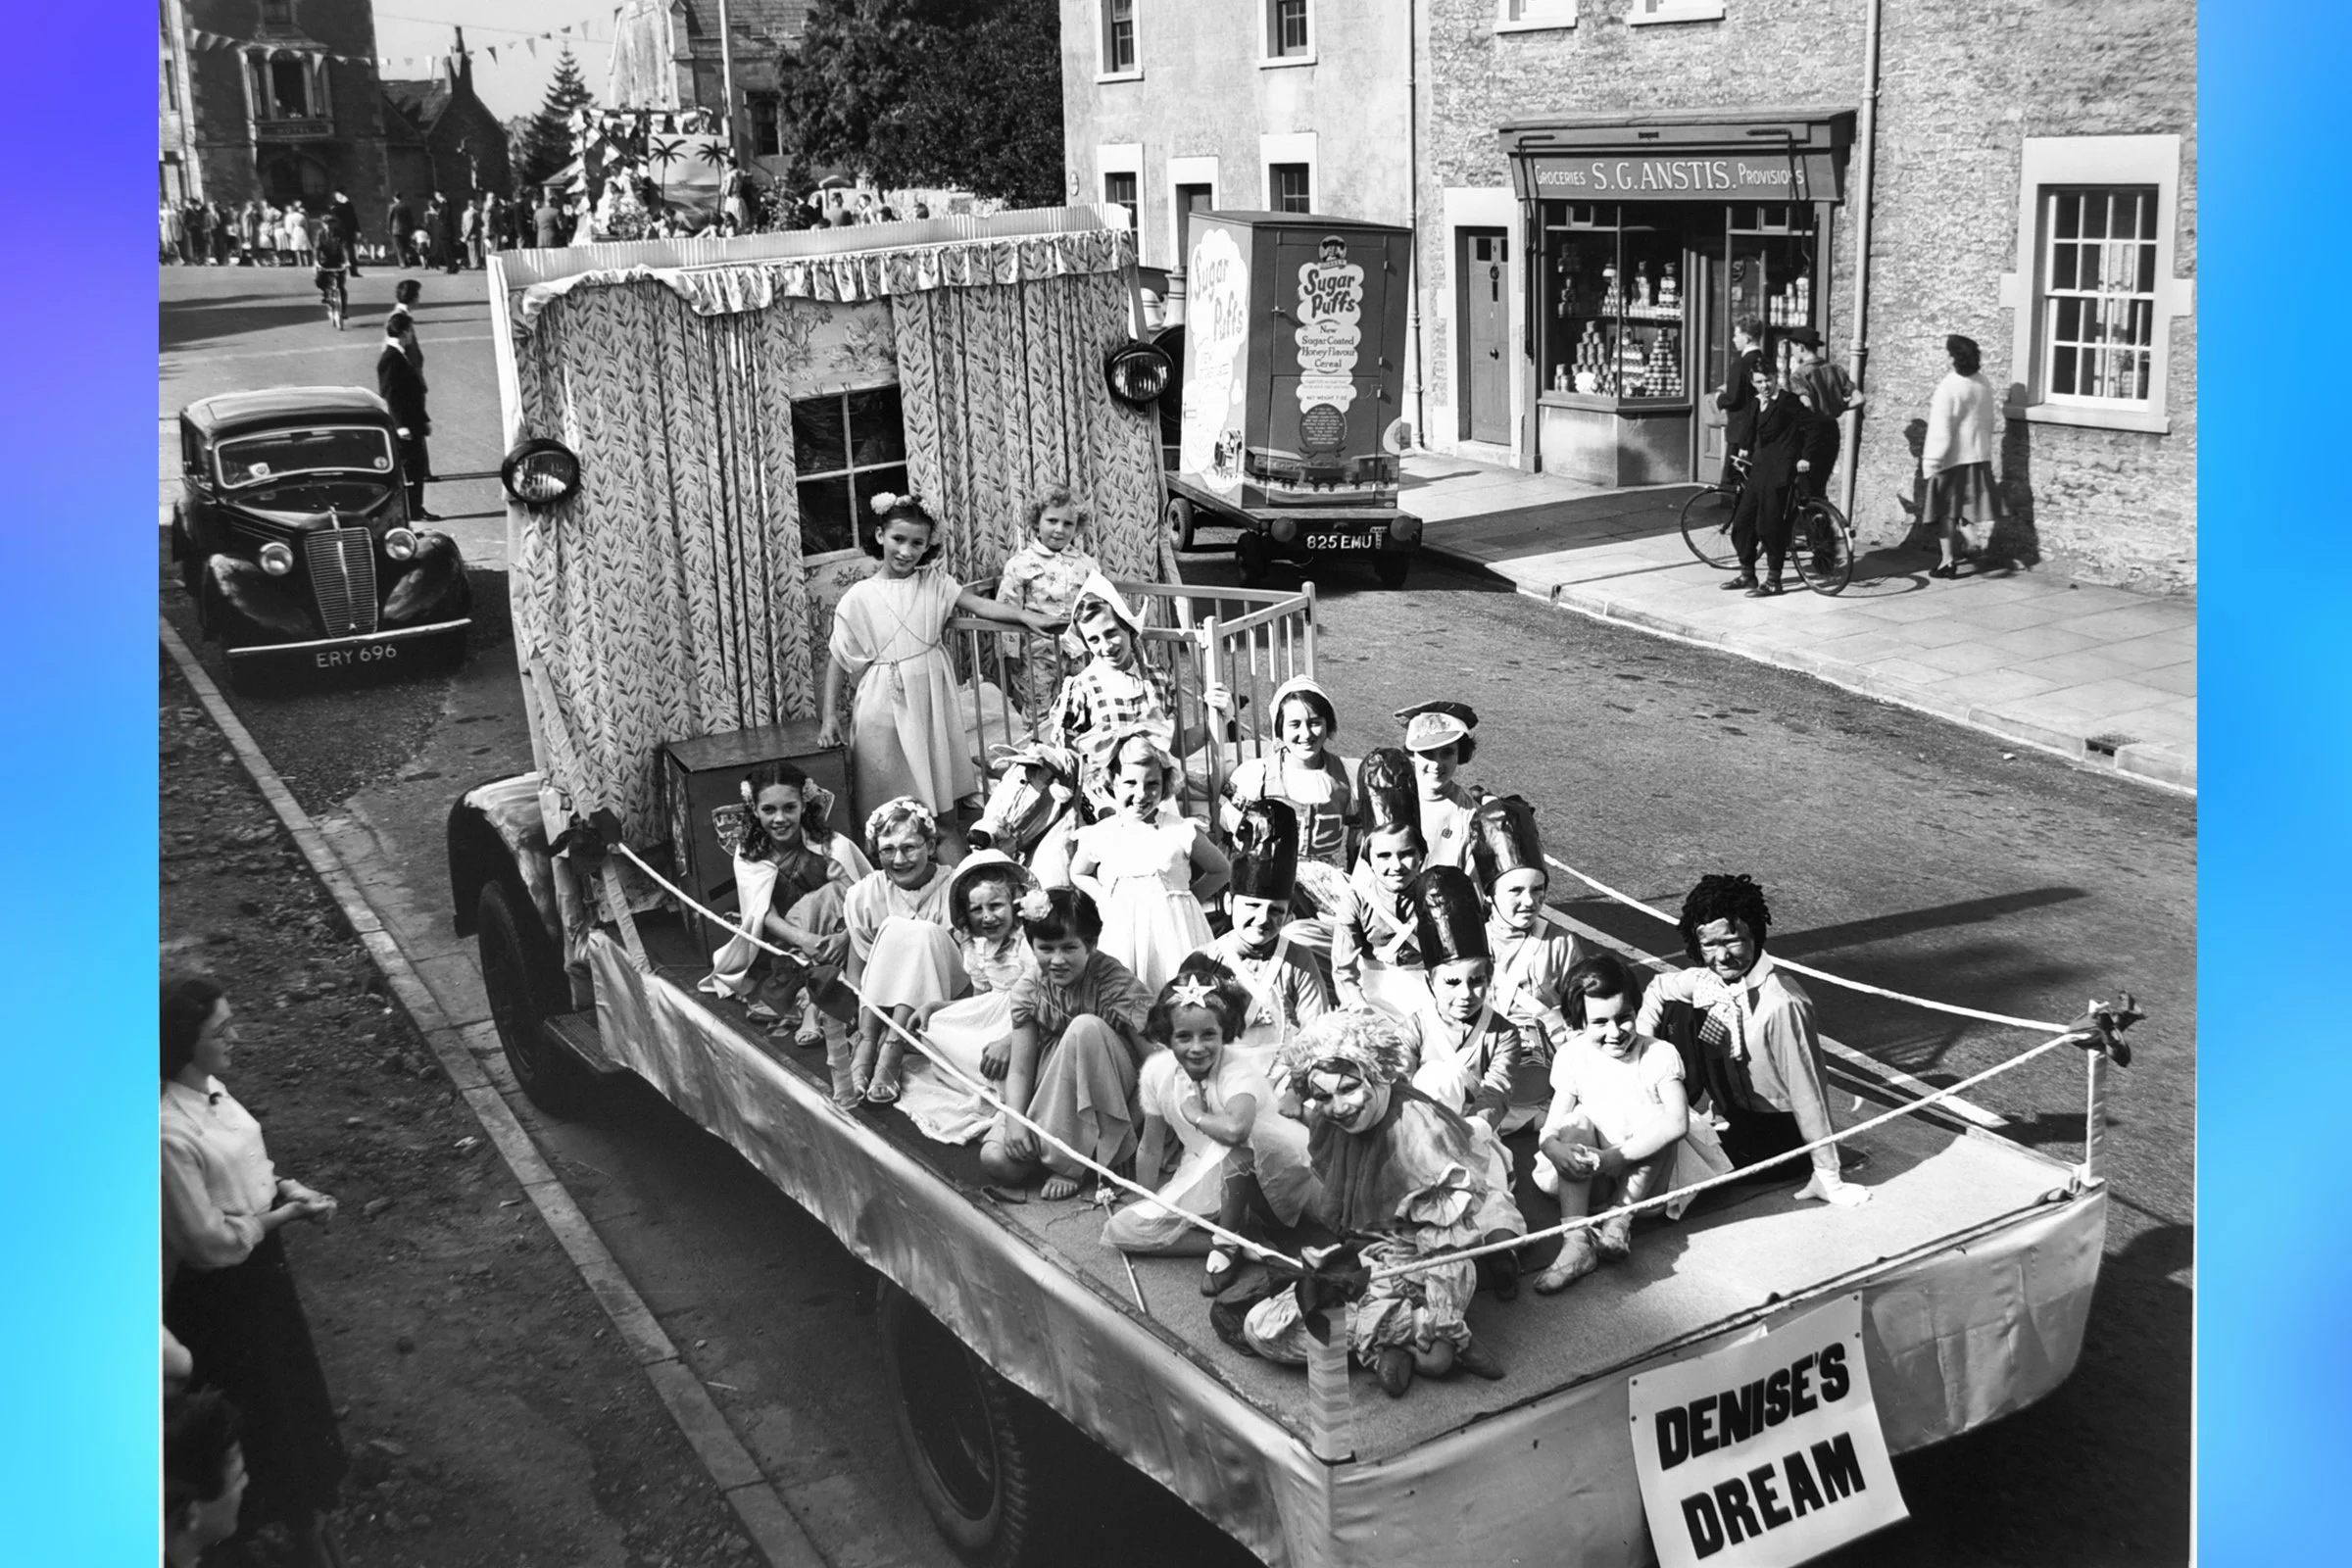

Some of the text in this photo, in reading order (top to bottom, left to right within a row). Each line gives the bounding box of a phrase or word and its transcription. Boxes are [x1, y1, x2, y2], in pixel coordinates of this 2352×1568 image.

[1535, 165, 1587, 185] GROCERIES
[1194, 249, 1229, 302] Sugar
[1303, 269, 1355, 297] Sugar
[1213, 287, 1243, 342] Puffs
[1311, 290, 1355, 318] Puffs
[1301, 335, 1354, 347] Sugar Coated
[1319, 324, 1338, 334] New
[1301, 346, 1327, 359] Honey
[1314, 359, 1342, 368] Cereal
[1307, 535, 1338, 549] 825
[317, 644, 397, 668] ERY 696
[1655, 1343, 1850, 1471] DENISE'S
[1681, 1431, 1866, 1560] DREAM
